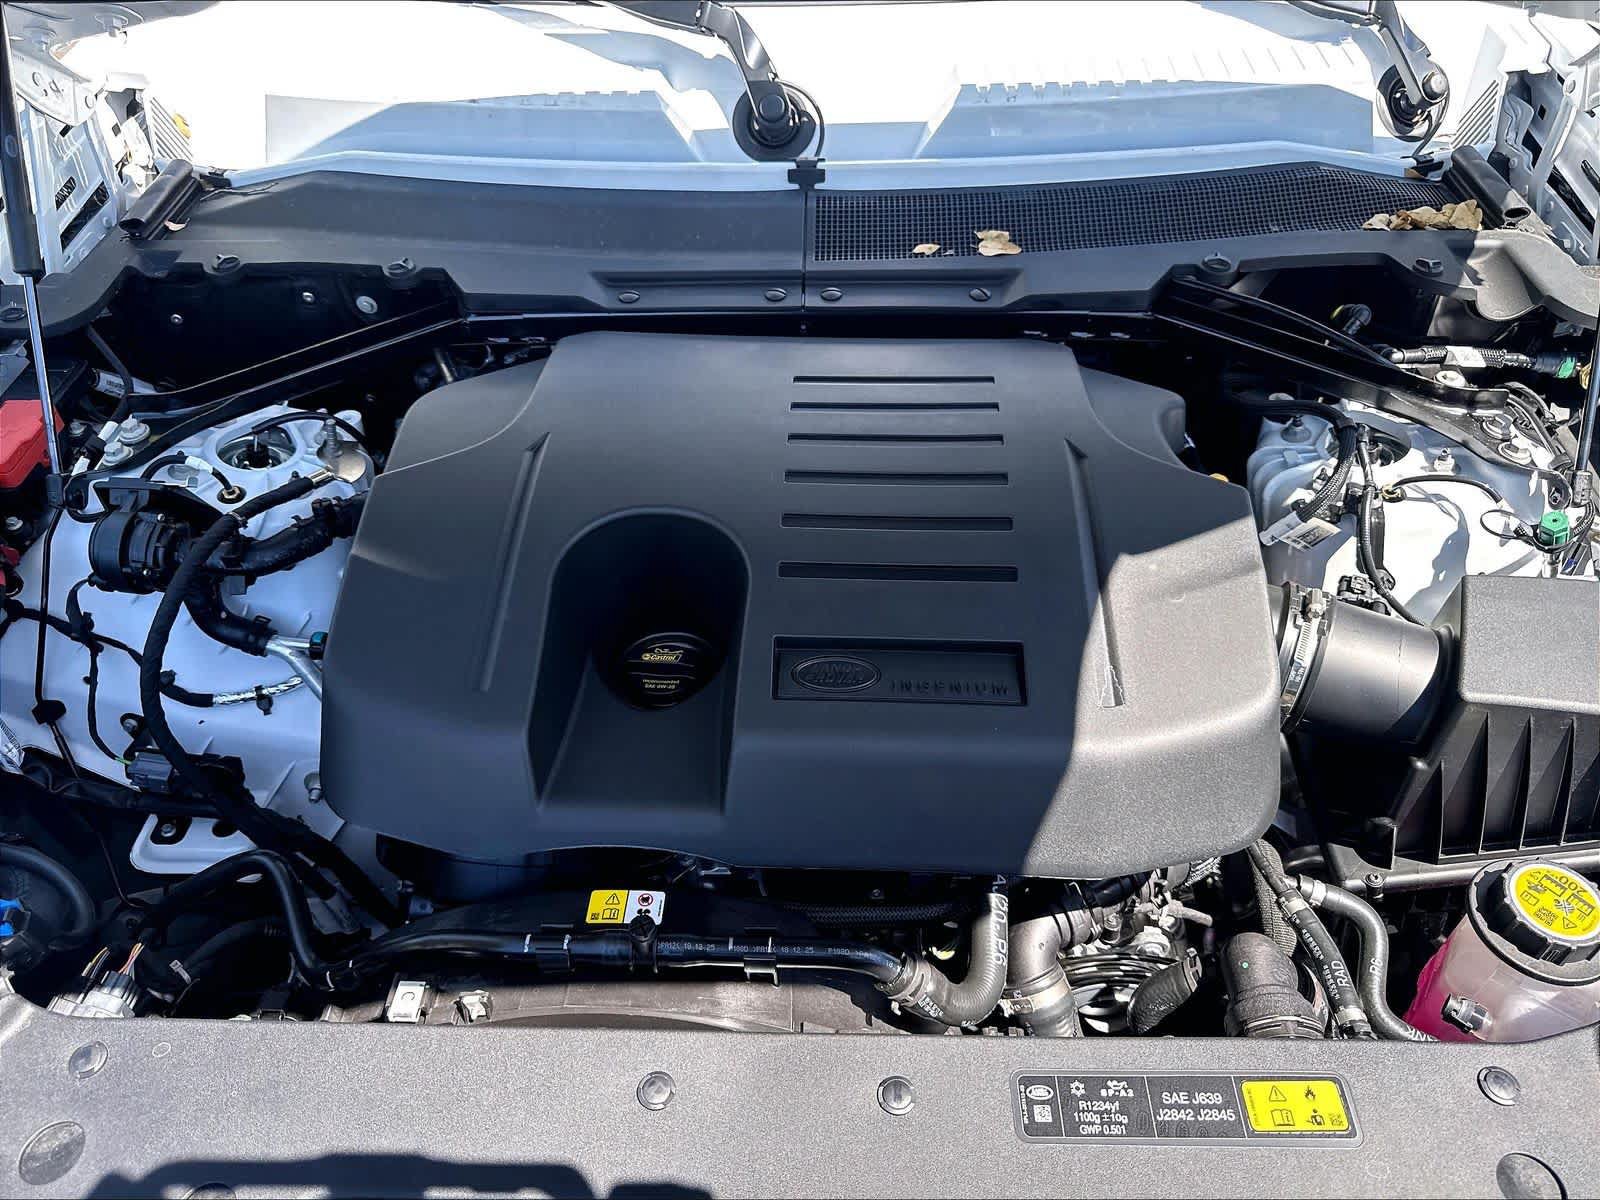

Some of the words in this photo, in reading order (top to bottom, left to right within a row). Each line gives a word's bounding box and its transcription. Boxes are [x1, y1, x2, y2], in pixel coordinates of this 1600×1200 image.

[889, 680, 1009, 696] INGENIUM
[1331, 960, 1350, 986] RAD
[1161, 1091, 1190, 1105] SAE
[1192, 1091, 1223, 1105] J639
[1078, 1101, 1120, 1113] R1234yf
[1074, 1112, 1101, 1124] 1100g
[1156, 1108, 1195, 1121] J2842
[1197, 1108, 1236, 1121] J2845
[1079, 1124, 1101, 1135] GWP
[1103, 1124, 1127, 1135] 0.501
